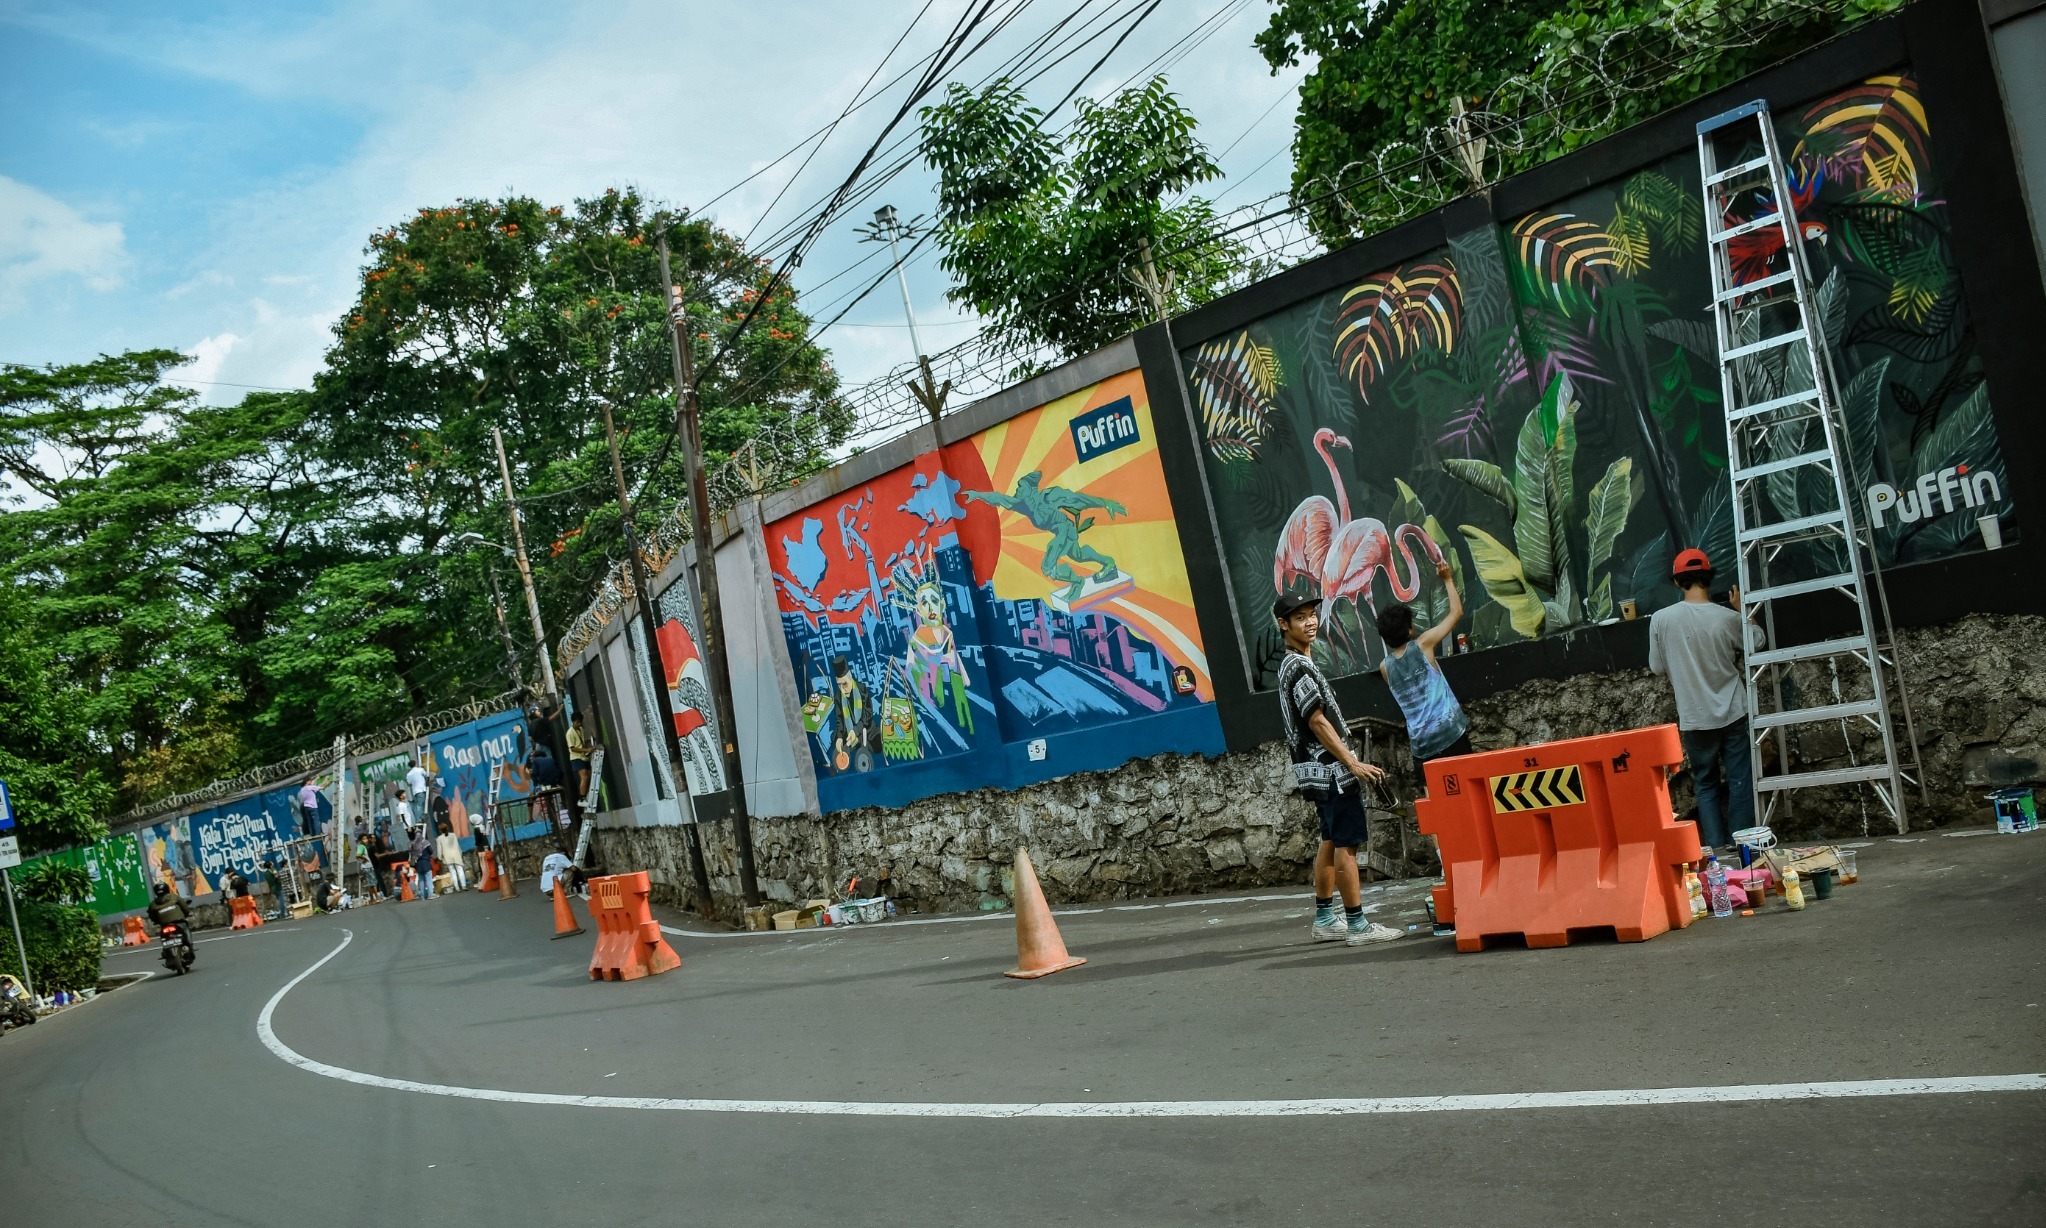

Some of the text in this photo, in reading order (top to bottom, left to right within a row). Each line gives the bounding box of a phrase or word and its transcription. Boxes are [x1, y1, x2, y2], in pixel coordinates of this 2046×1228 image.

[1077, 412, 1134, 454] Puffin
[1867, 465, 2001, 529] Puffin
[1523, 757, 1539, 767] 31
[199, 824, 223, 851] Kalau
